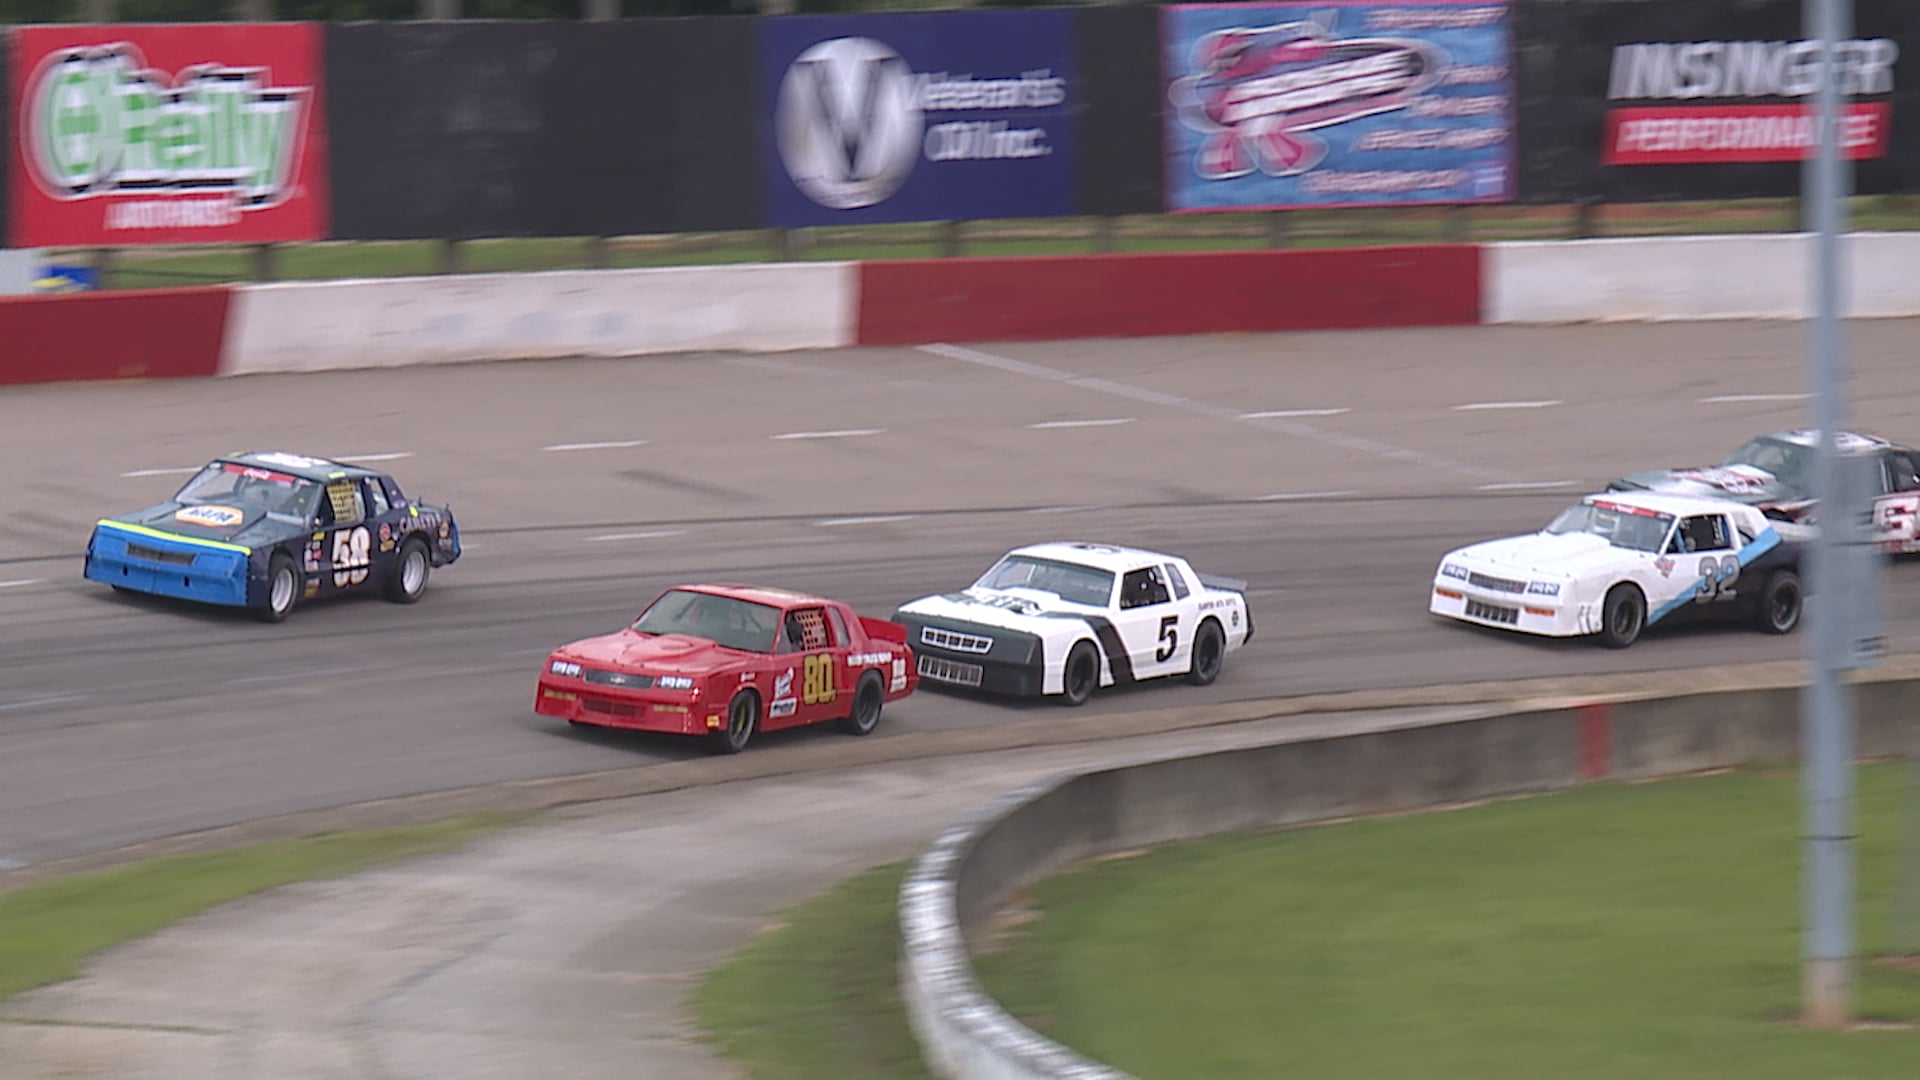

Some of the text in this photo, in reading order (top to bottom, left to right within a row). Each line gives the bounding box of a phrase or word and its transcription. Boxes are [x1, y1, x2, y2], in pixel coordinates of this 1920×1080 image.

[1615, 113, 1880, 152] PERFORMAE
[1695, 554, 1741, 604] 32
[1156, 615, 1178, 663] 5
